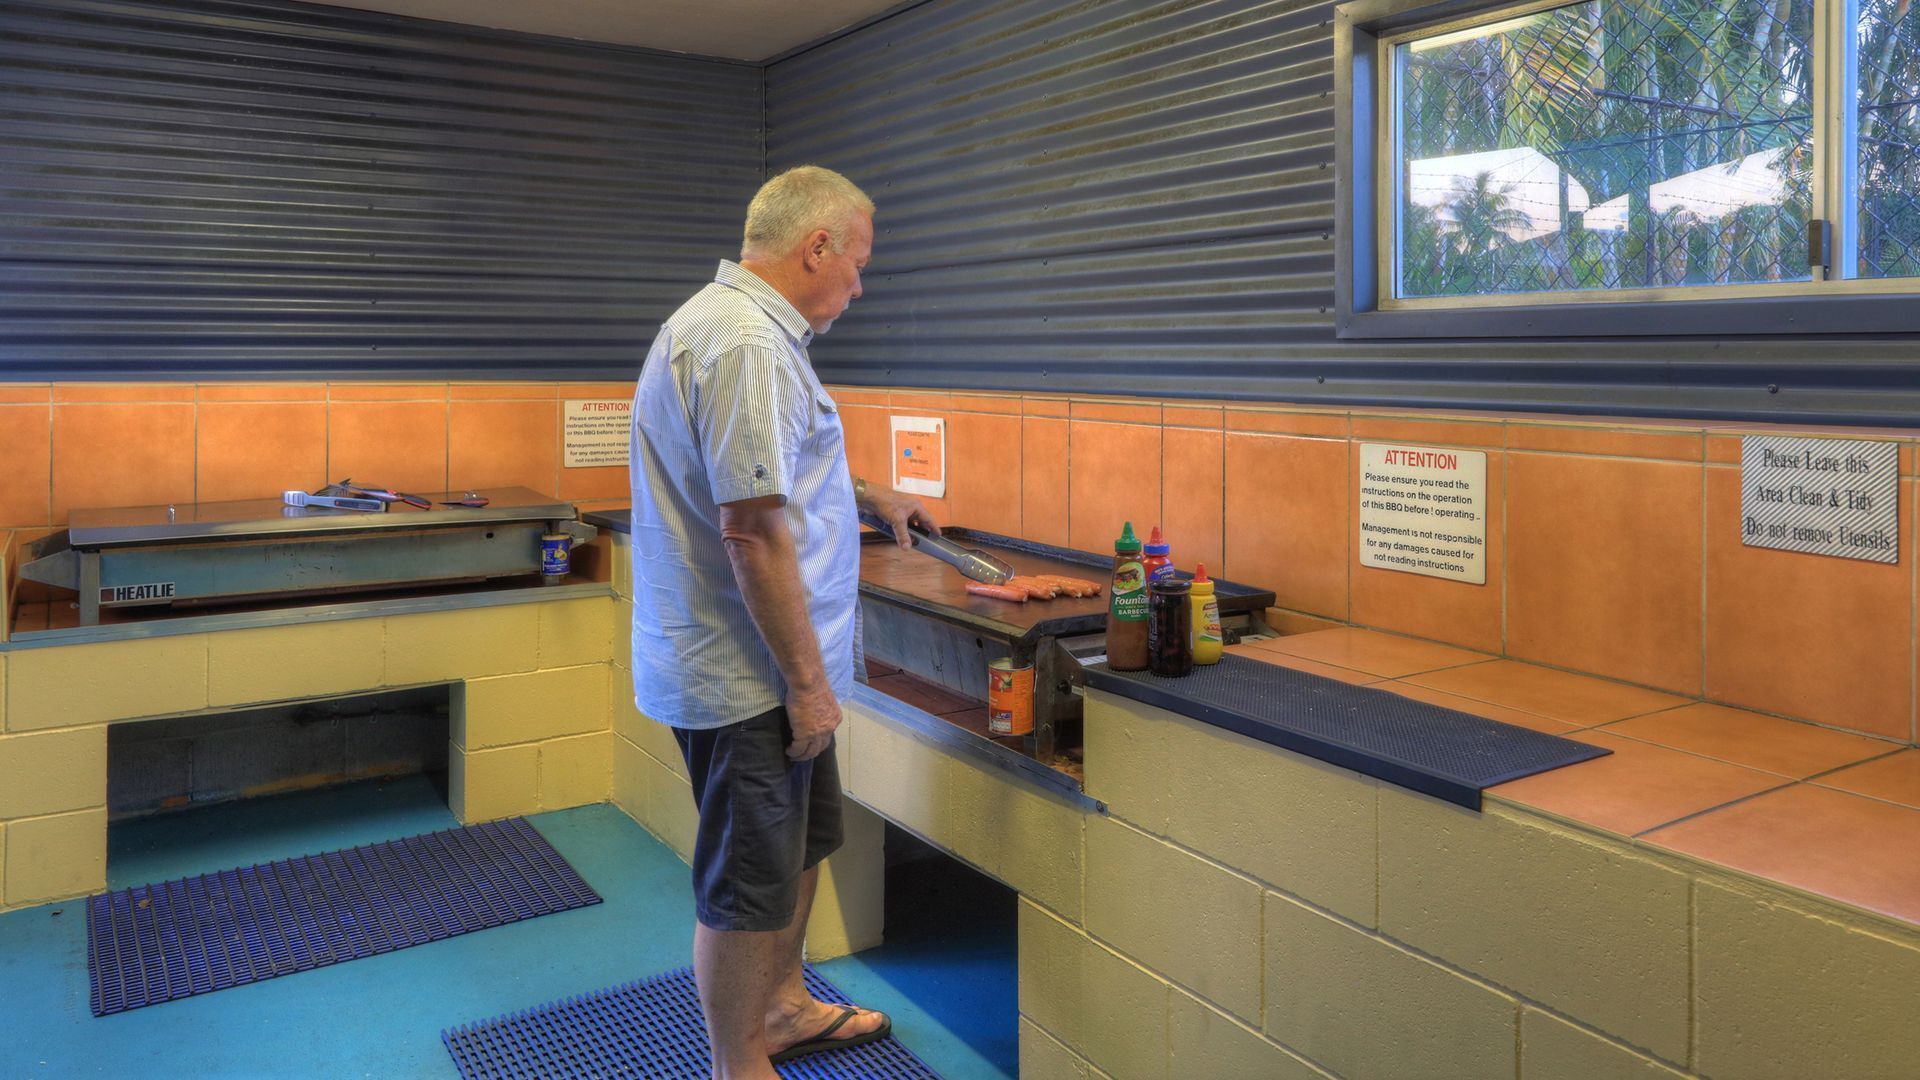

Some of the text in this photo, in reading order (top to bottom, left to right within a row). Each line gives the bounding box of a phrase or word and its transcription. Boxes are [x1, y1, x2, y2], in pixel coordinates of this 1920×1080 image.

[582, 402, 630, 412] ATTENTION
[1384, 449, 1457, 470] ATTENTION
[1763, 448, 1870, 474] Please Leave this
[1365, 472, 1470, 490] Please ensure you read the
[1362, 486, 1404, 498] instructions
[1418, 491, 1431, 500] the
[1432, 493, 1472, 504] operation
[1754, 485, 1783, 503] Area
[1788, 485, 1823, 507] Clean
[1829, 488, 1840, 508] &
[1371, 500, 1384, 510] this
[1386, 502, 1402, 512] BBQ
[1404, 504, 1430, 515] before
[1362, 522, 1482, 546] Management is not responsible
[1746, 516, 1891, 550] Do not remove Utensils
[1366, 538, 1474, 560] for any damages caused for
[1374, 553, 1465, 572] not reading instructions
[116, 583, 174, 600] HEATLIE
